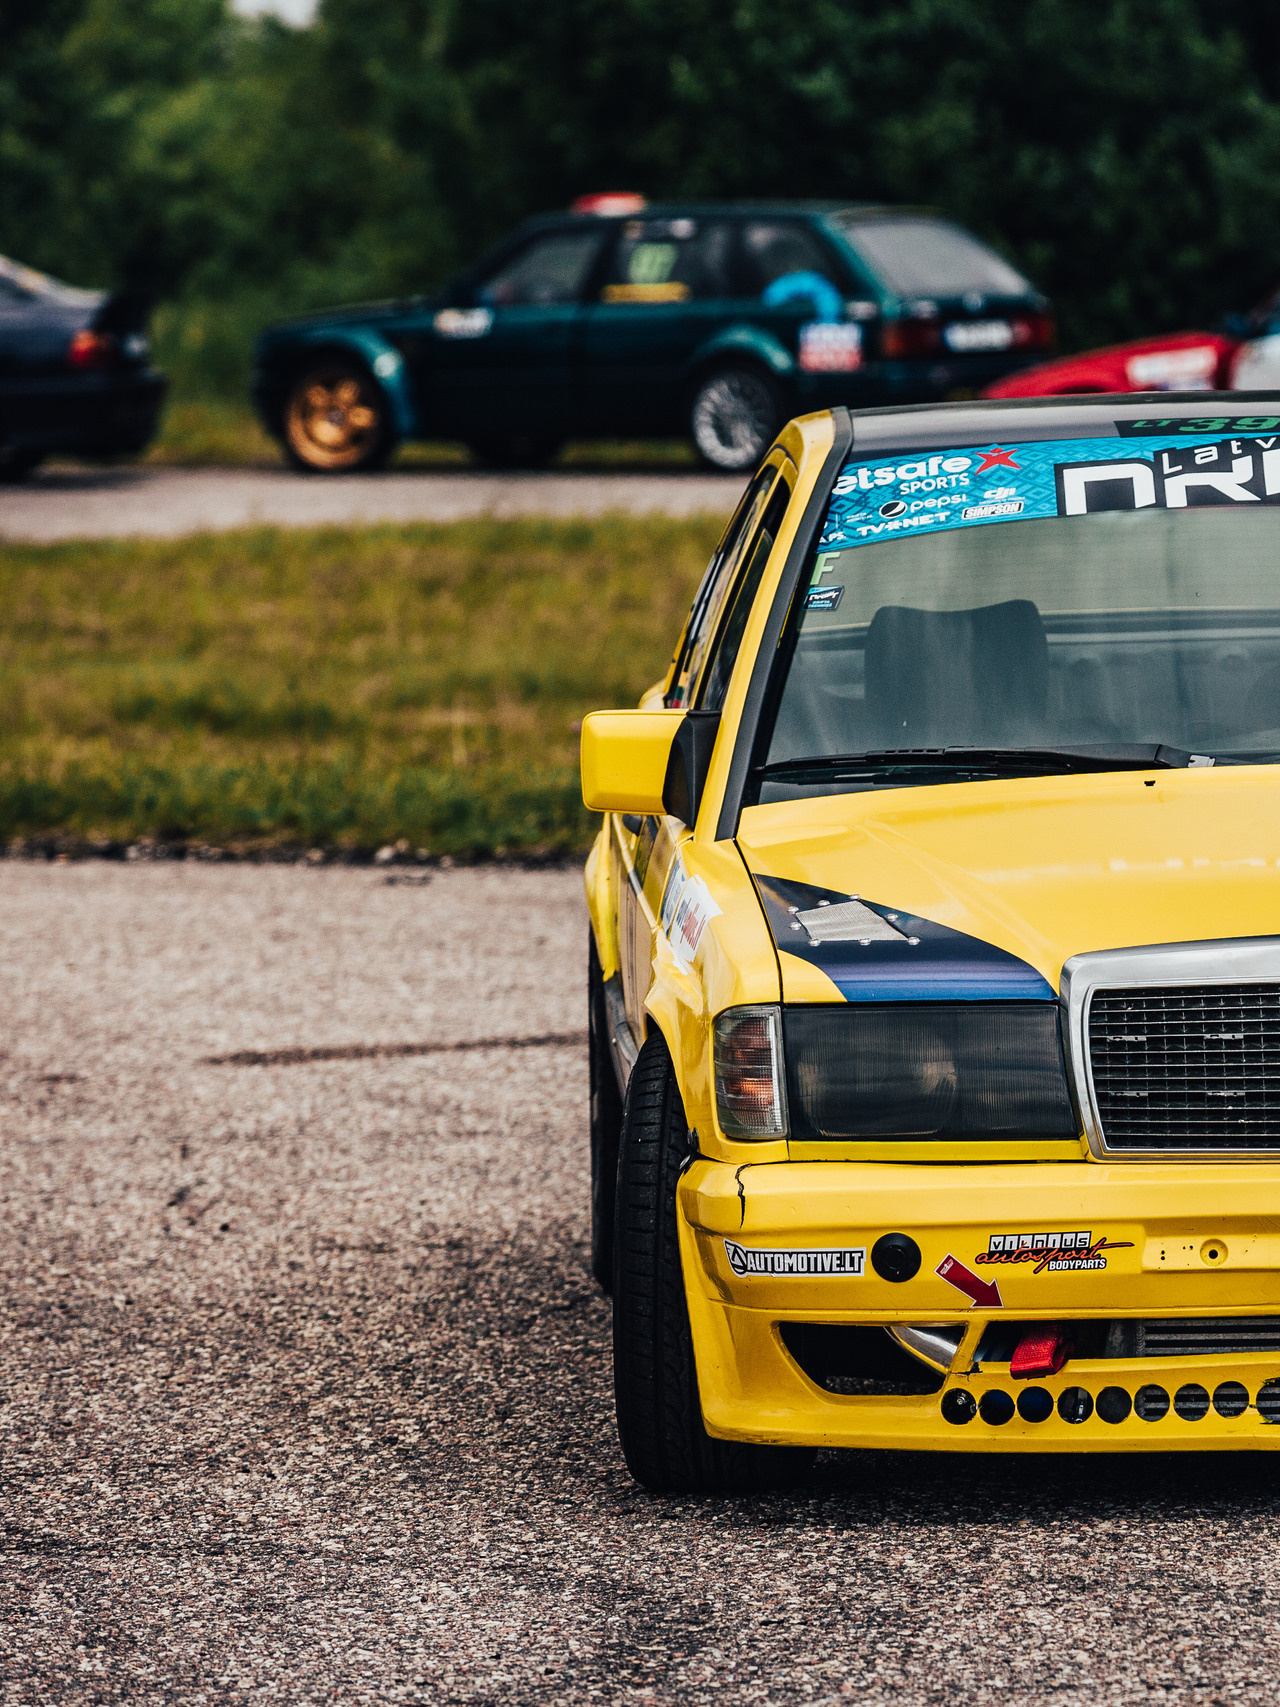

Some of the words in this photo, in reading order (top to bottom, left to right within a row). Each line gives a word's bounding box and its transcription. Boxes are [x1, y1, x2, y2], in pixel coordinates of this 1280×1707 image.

[1131, 419, 1182, 428] LT
[900, 473, 970, 496] SPORTS
[909, 494, 968, 513] pepsi
[964, 503, 1021, 519] SIMPSON
[991, 1232, 1091, 1250] VILNIUS
[746, 1251, 862, 1273] AUTOMOTIVE.LT
[976, 1237, 1134, 1274] autosport
[1048, 1259, 1107, 1271] BODYPARTS
